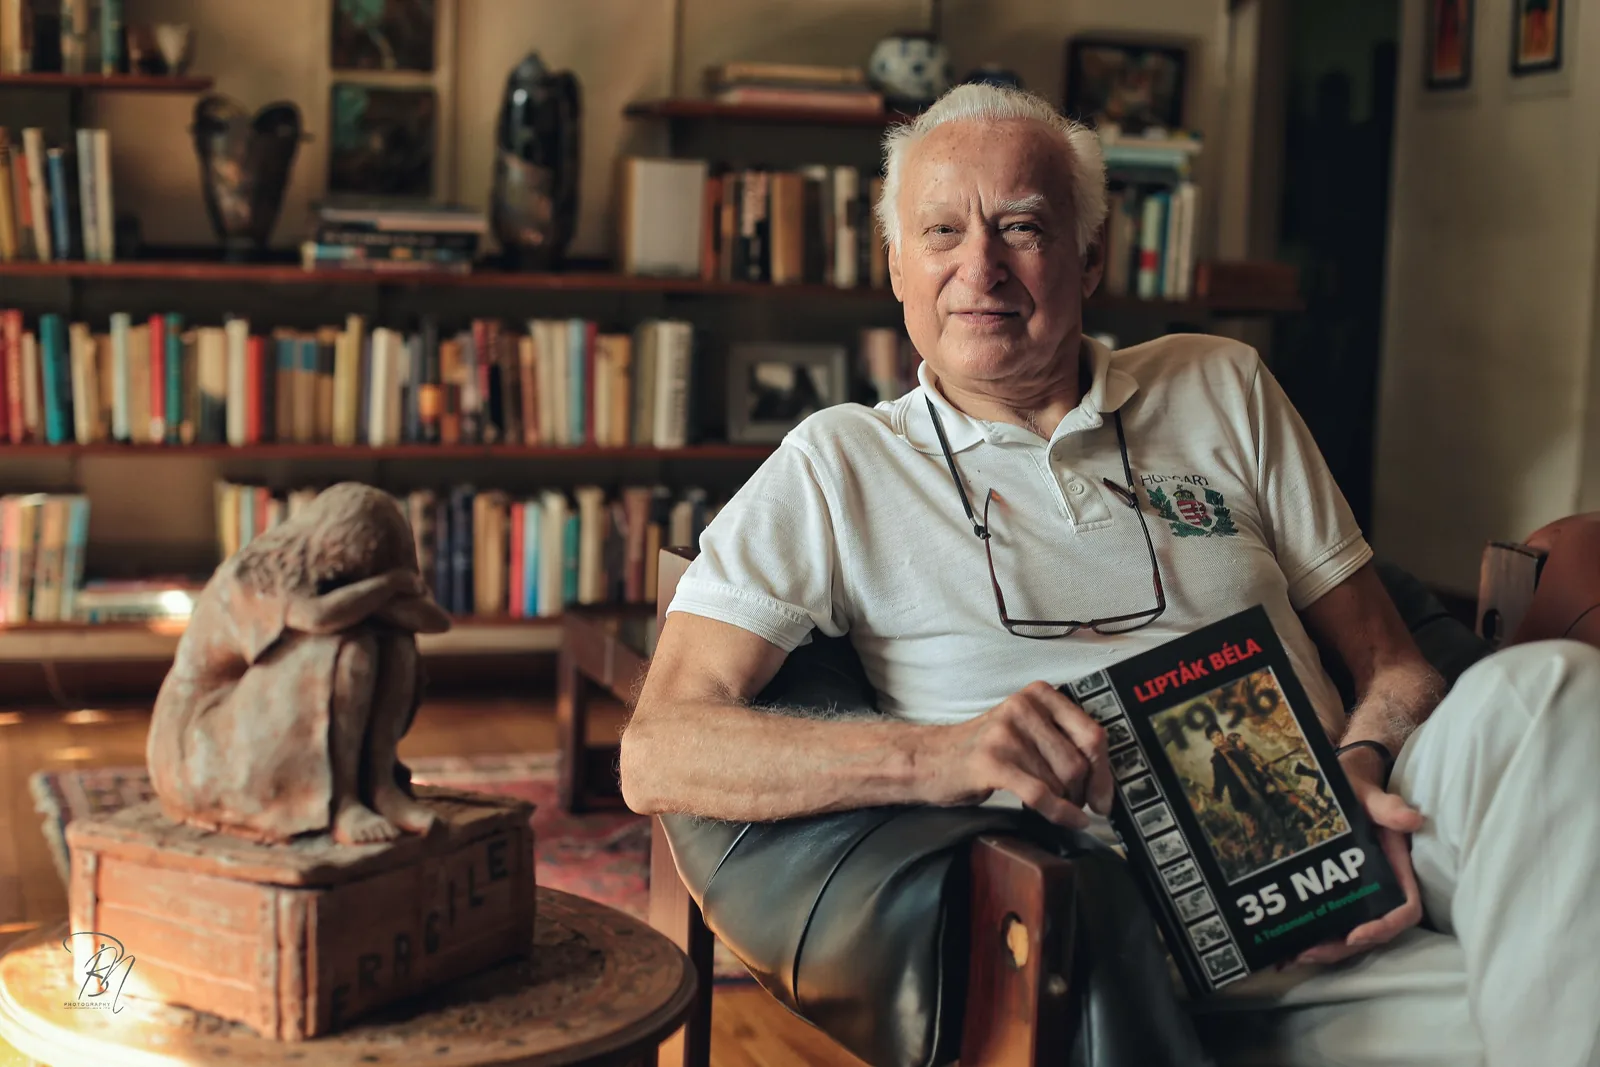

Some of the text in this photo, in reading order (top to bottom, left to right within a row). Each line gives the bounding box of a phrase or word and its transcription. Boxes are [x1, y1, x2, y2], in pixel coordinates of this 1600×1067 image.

[1140, 474, 1209, 486] HUARY
[1133, 638, 1263, 703] LIPTÁK BÉLA
[1236, 847, 1366, 926] 35 NAP
